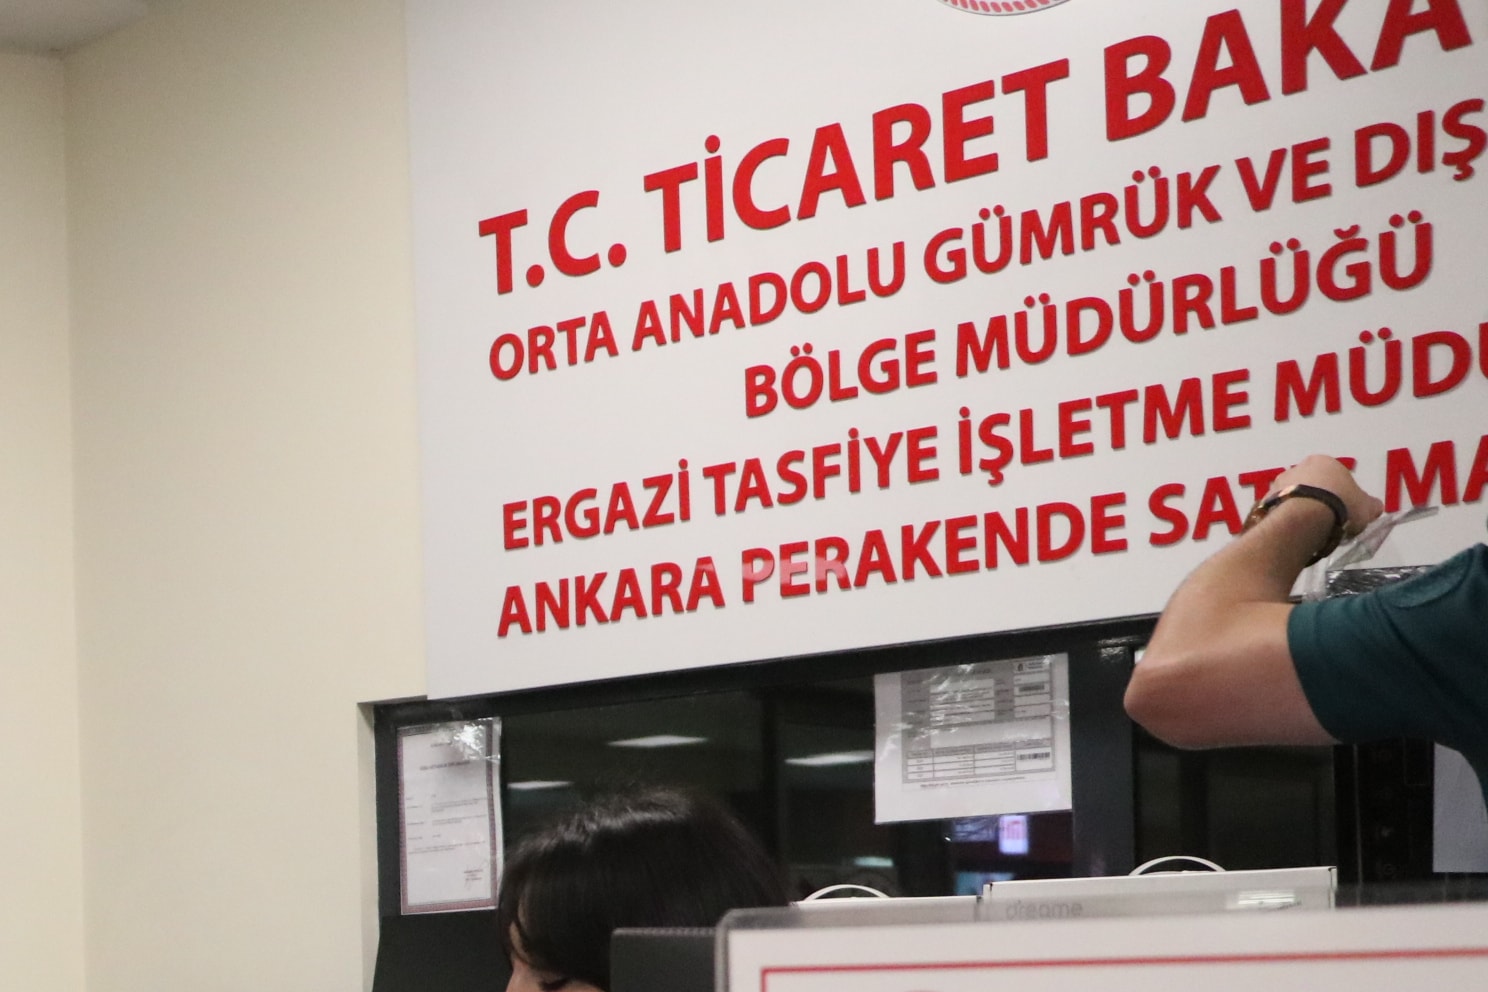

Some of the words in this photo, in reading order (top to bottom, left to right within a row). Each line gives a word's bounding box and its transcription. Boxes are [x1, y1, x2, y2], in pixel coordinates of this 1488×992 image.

[478, 189, 628, 294] T.C.
[643, 57, 1070, 253] TİCARET
[489, 310, 620, 380] ORTA
[631, 240, 907, 351] ANADOLU
[923, 164, 1222, 283] GÜMRÜK
[1235, 137, 1332, 211] VE
[1355, 98, 1488, 187] DIŞ
[745, 328, 939, 417] BÖLGE
[956, 209, 1433, 377] MÜDÜRLÜĞÜ
[497, 555, 726, 637] ANKARA
[741, 491, 1129, 603] PERAKENDE
[1148, 456, 1357, 546] SAT
[503, 457, 692, 550] ERGAZİ
[702, 425, 940, 515] TASFİYE
[958, 367, 1252, 486] İŞLETME
[1274, 321, 1488, 422] MÜD
